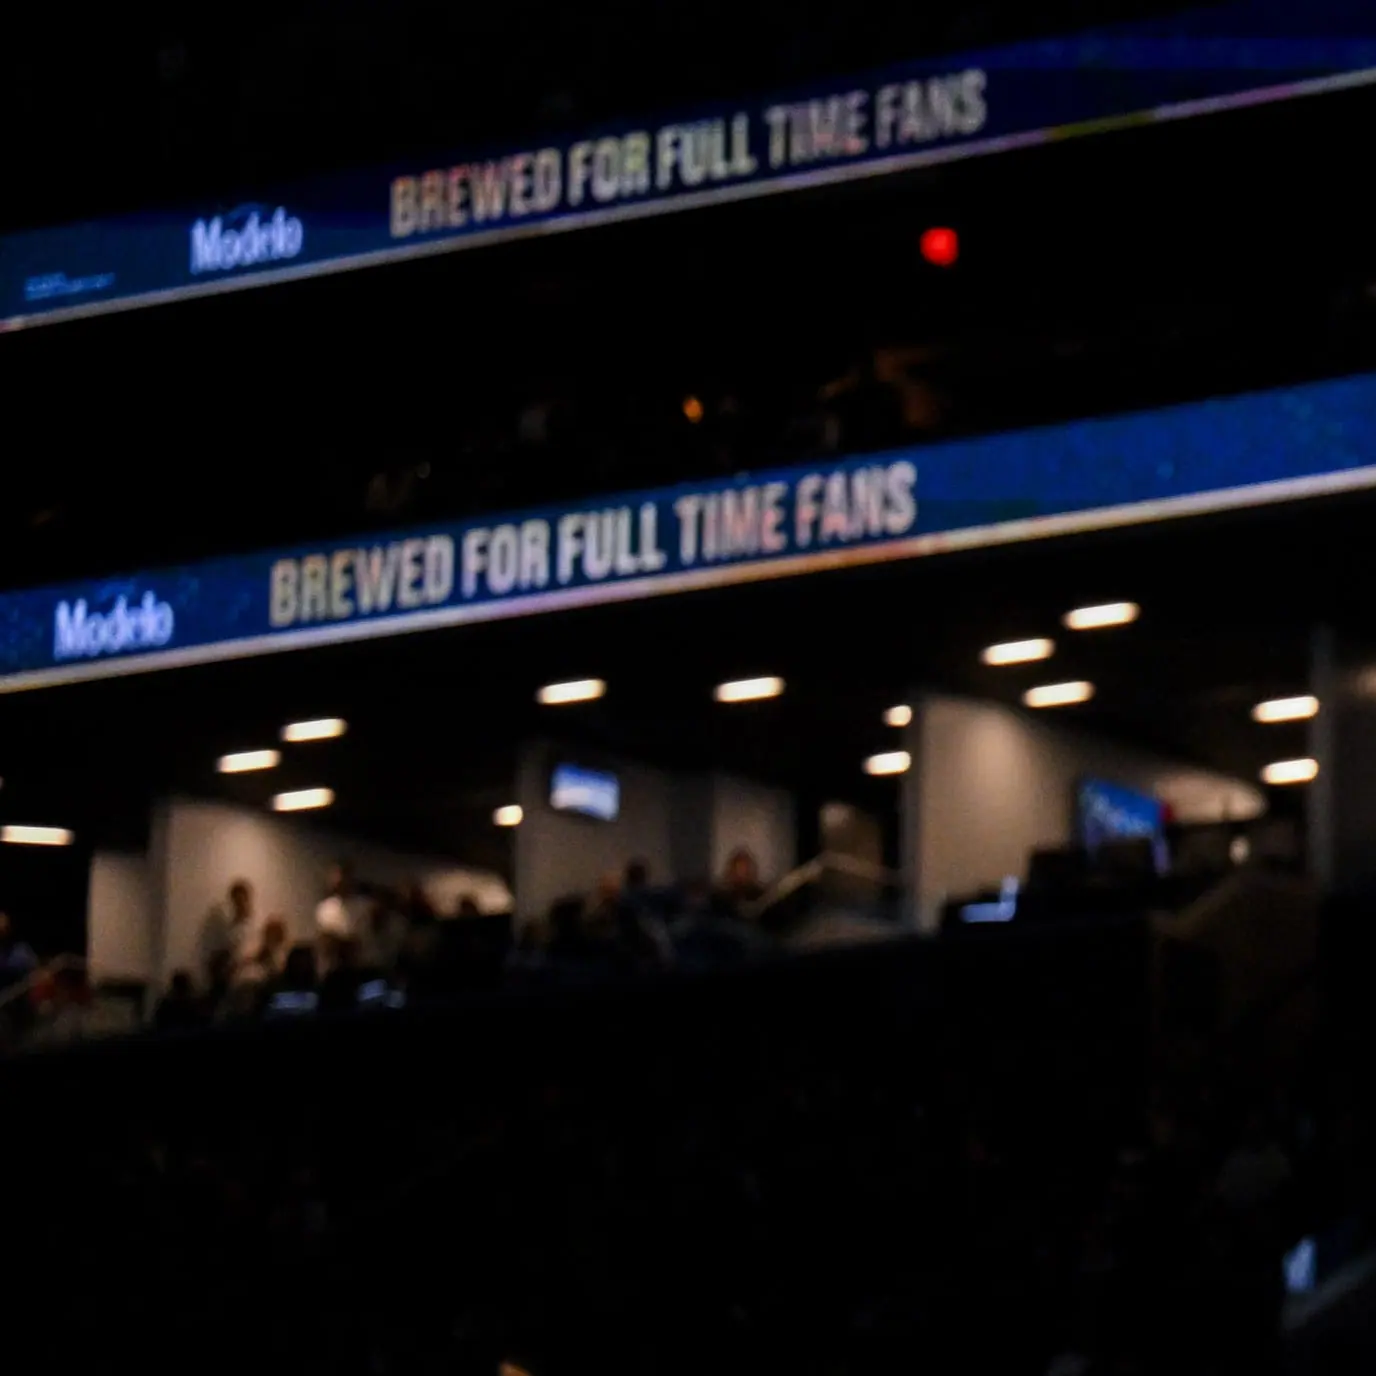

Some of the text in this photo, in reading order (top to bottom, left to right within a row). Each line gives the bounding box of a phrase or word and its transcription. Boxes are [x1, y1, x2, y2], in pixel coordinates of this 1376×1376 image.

[390, 69, 988, 238] BREWED FOR FULL TIME FANS
[190, 206, 303, 275] Modelo
[269, 461, 918, 628] BREWED FOR FULL TIME FANS
[54, 590, 174, 661] Modelo
